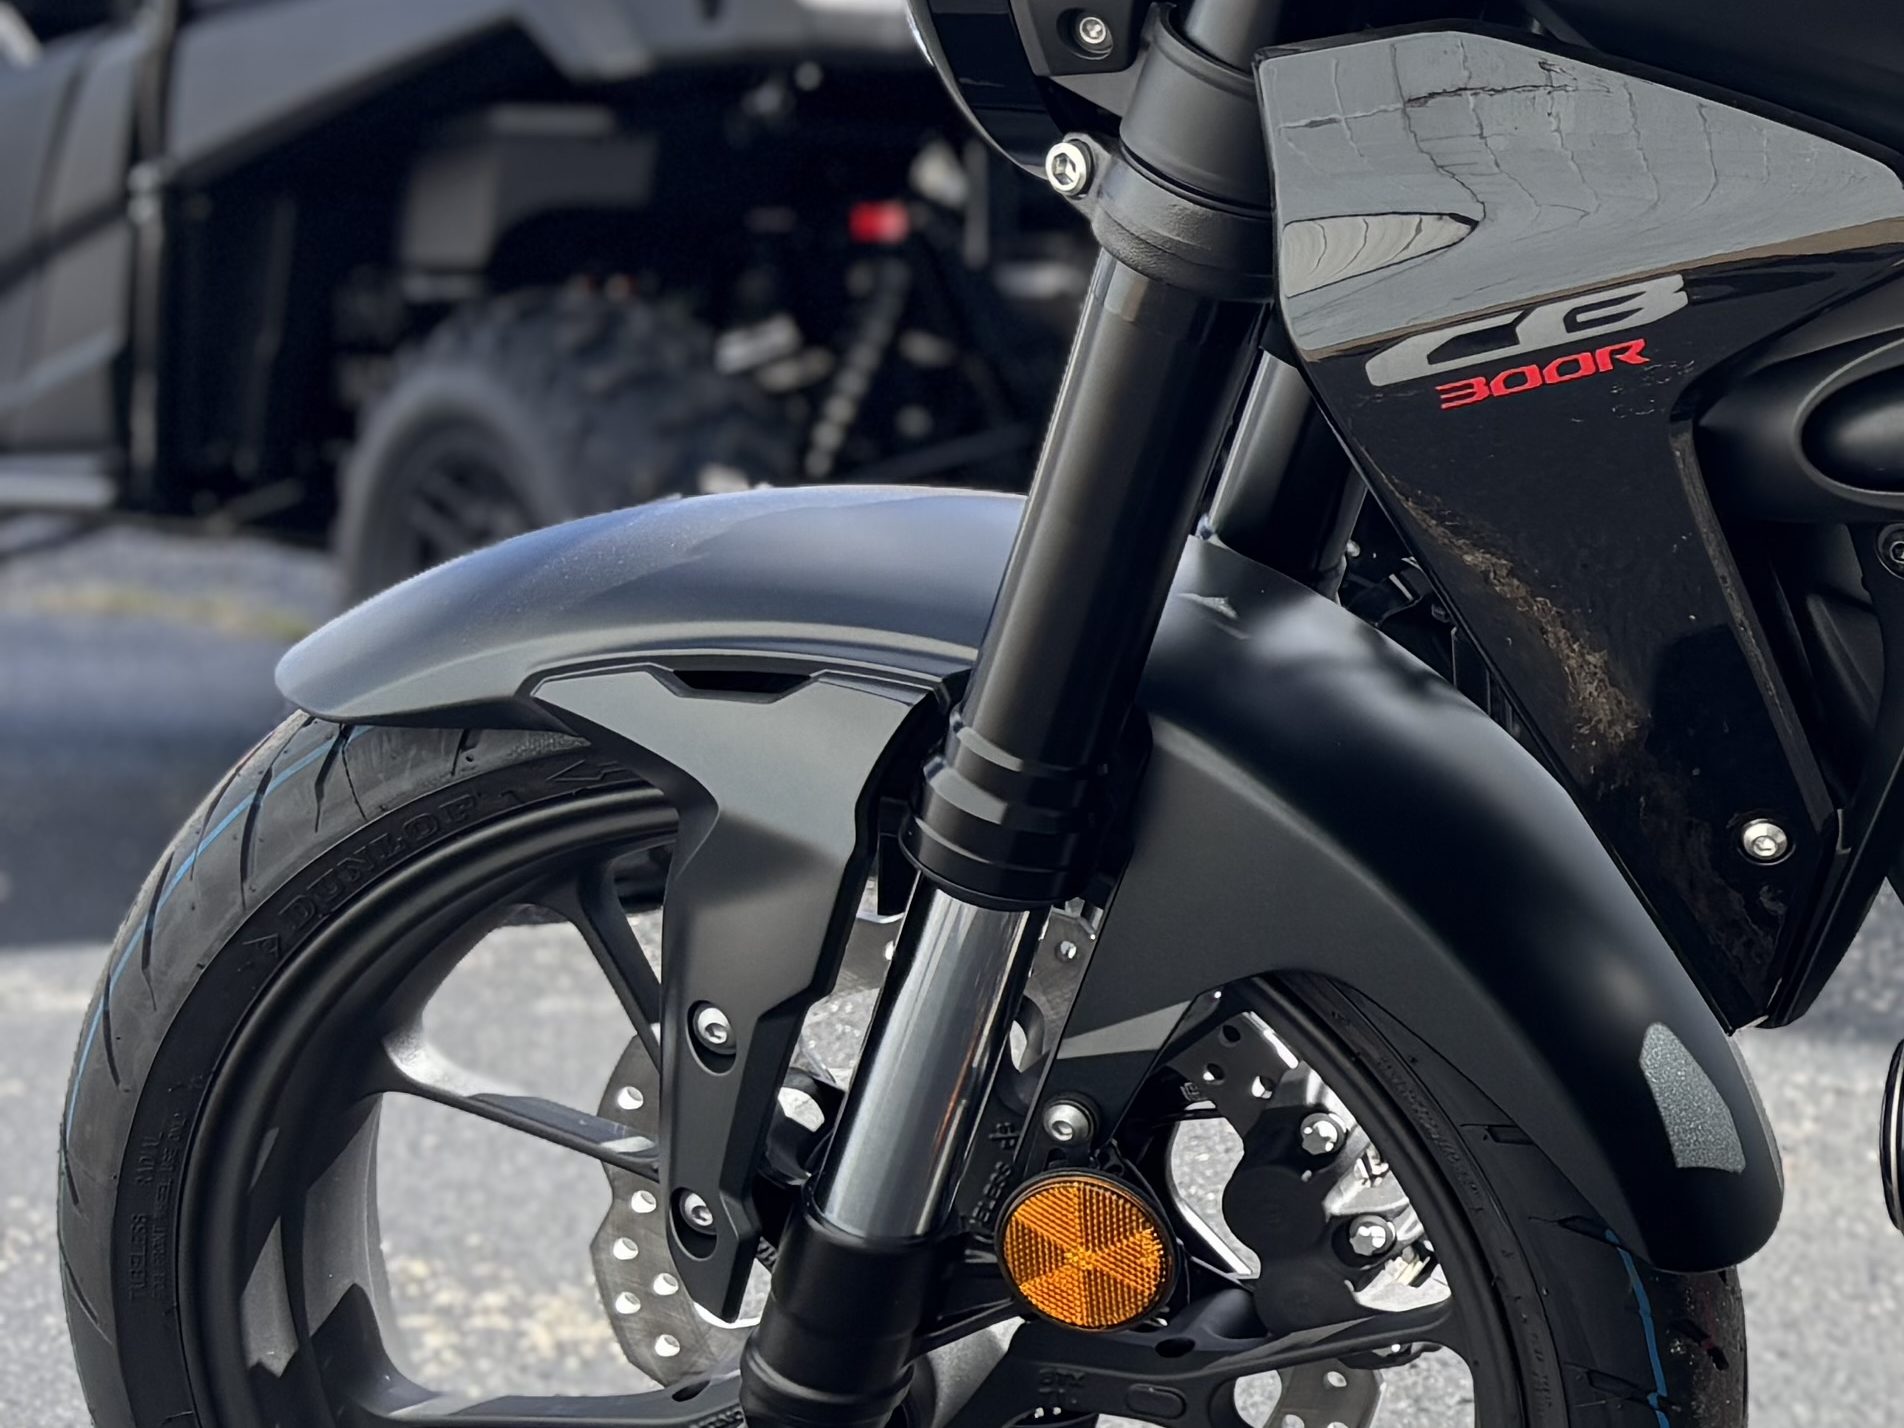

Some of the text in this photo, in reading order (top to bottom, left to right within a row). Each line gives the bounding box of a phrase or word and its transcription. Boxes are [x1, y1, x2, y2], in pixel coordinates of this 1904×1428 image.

[1364, 273, 1690, 388] CB
[1435, 337, 1650, 410] 300R
[283, 793, 480, 941] DUNLOP
[129, 1213, 148, 1301] TUBELESS
